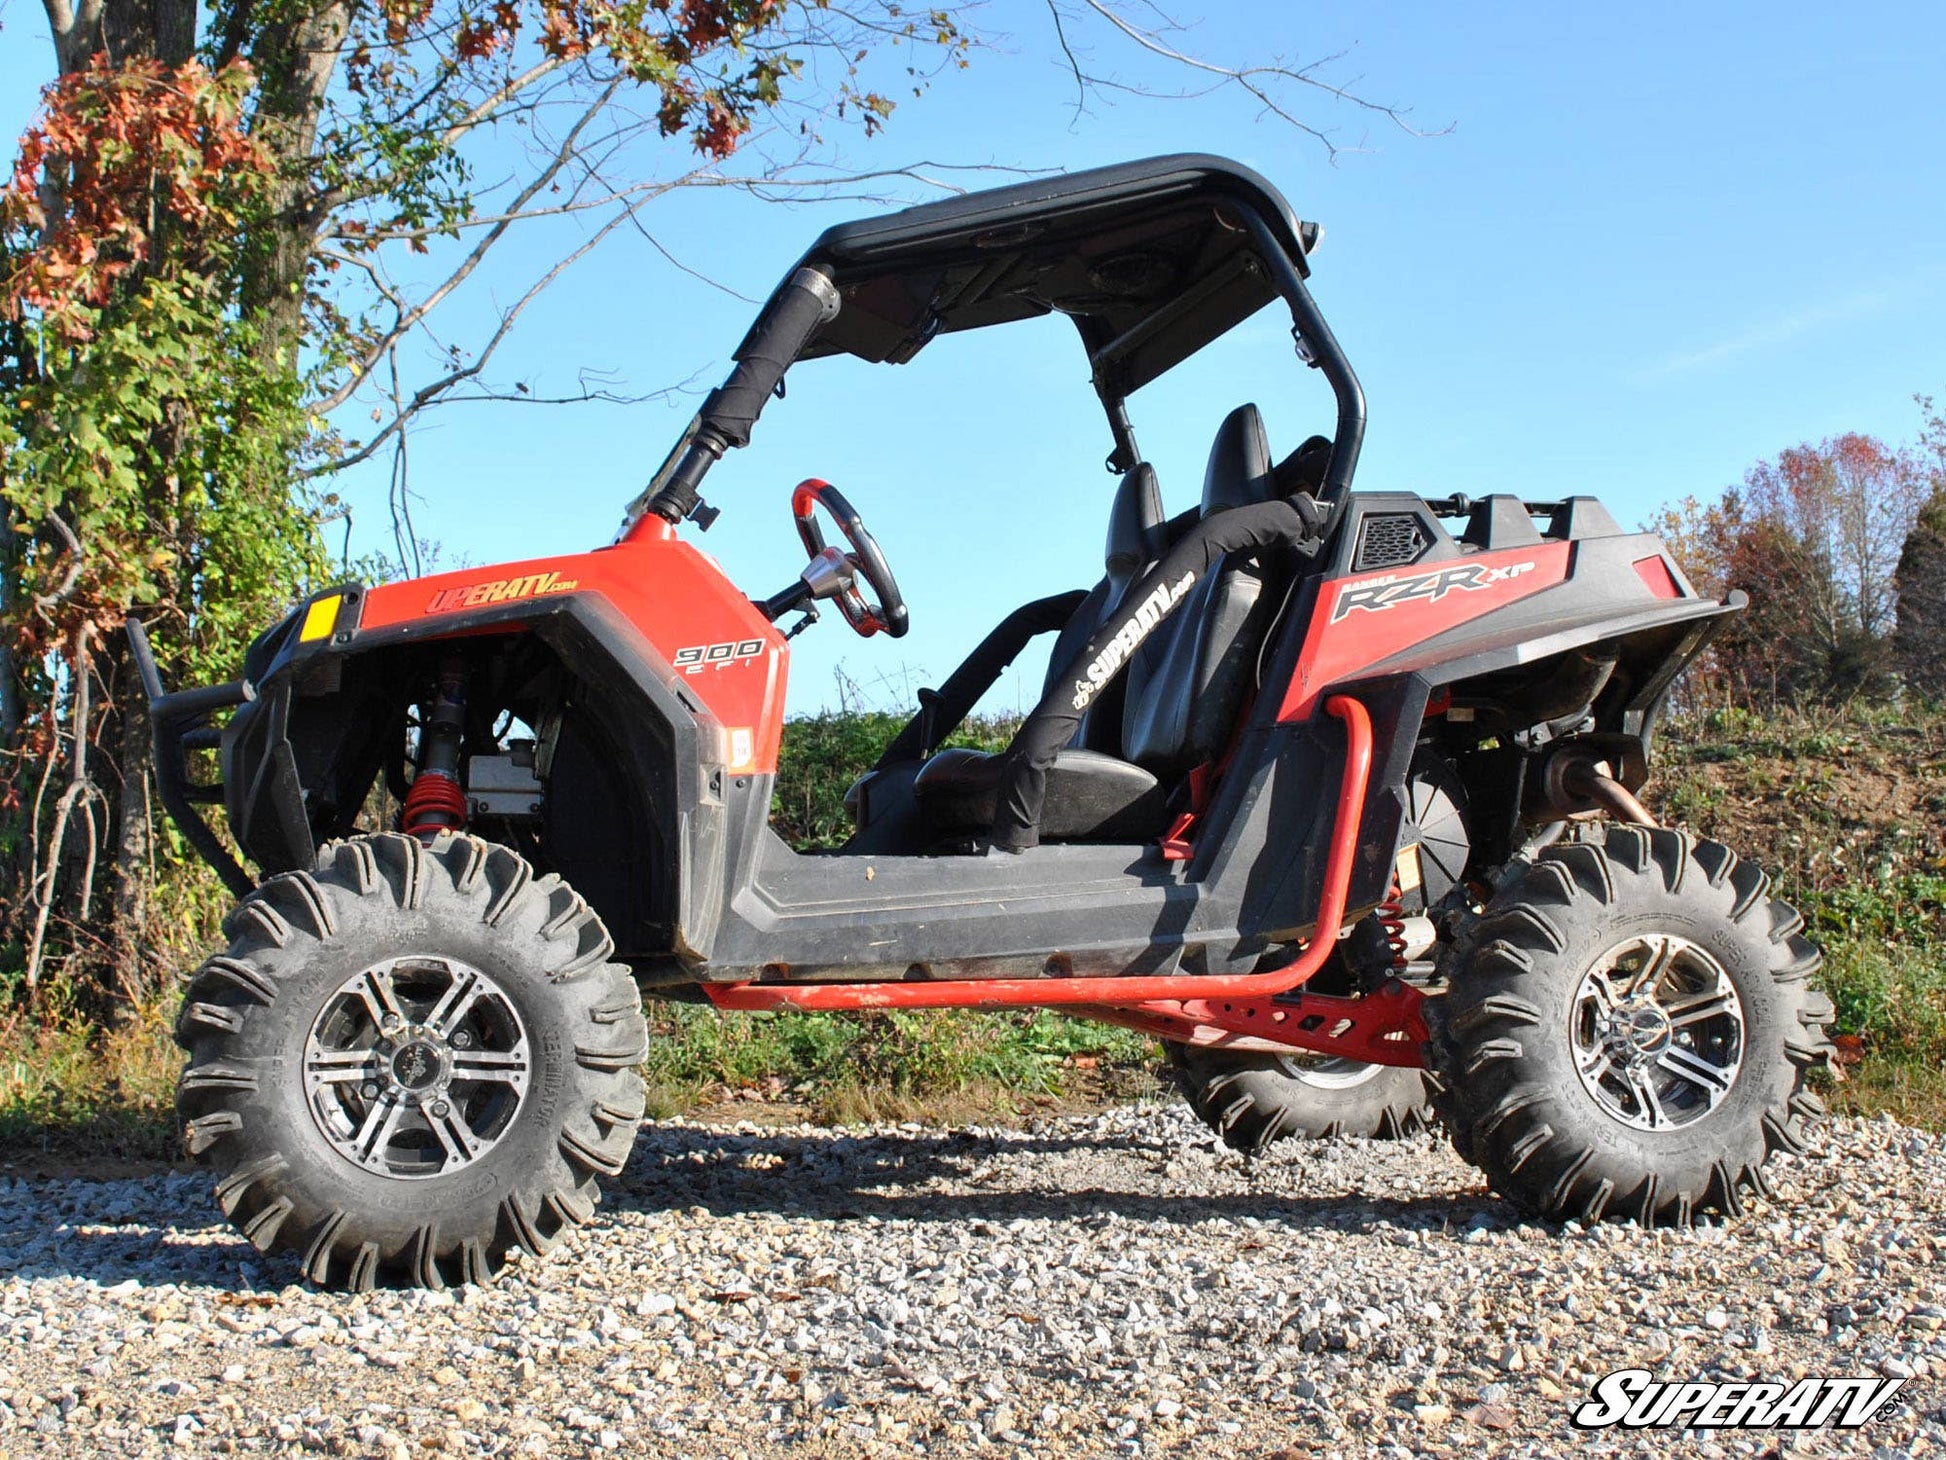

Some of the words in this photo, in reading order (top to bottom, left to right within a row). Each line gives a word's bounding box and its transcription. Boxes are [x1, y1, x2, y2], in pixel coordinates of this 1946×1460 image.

[1330, 563, 1491, 624] RZR
[1486, 562, 1535, 582] XP
[673, 638, 766, 667] 900
